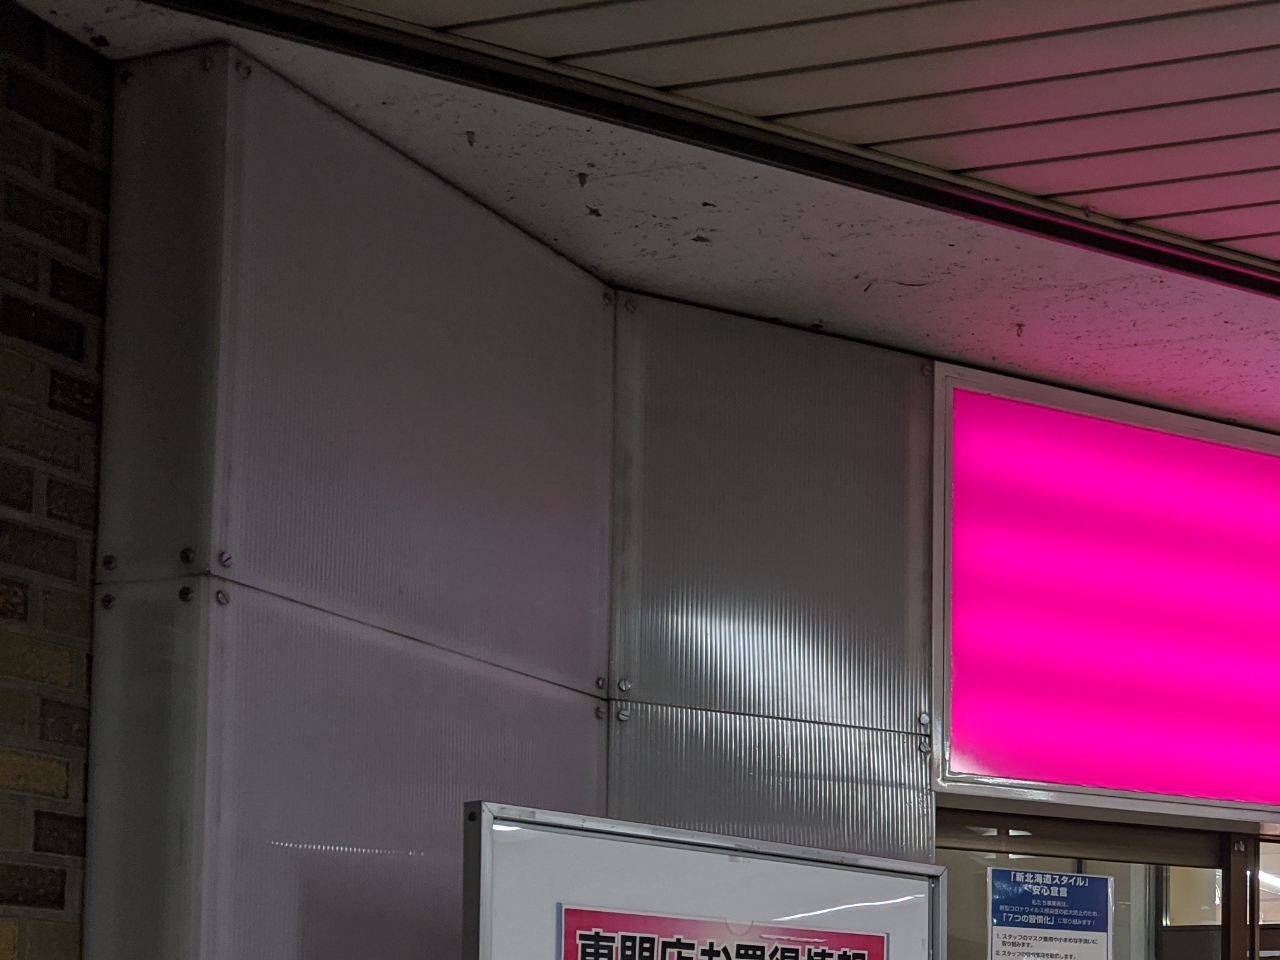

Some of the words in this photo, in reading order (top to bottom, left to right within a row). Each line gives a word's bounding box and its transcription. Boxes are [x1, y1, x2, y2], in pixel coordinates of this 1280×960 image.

[1010, 872, 1089, 886] 「新北海道スタイル」
[1033, 885, 1067, 897] 安心宣言
